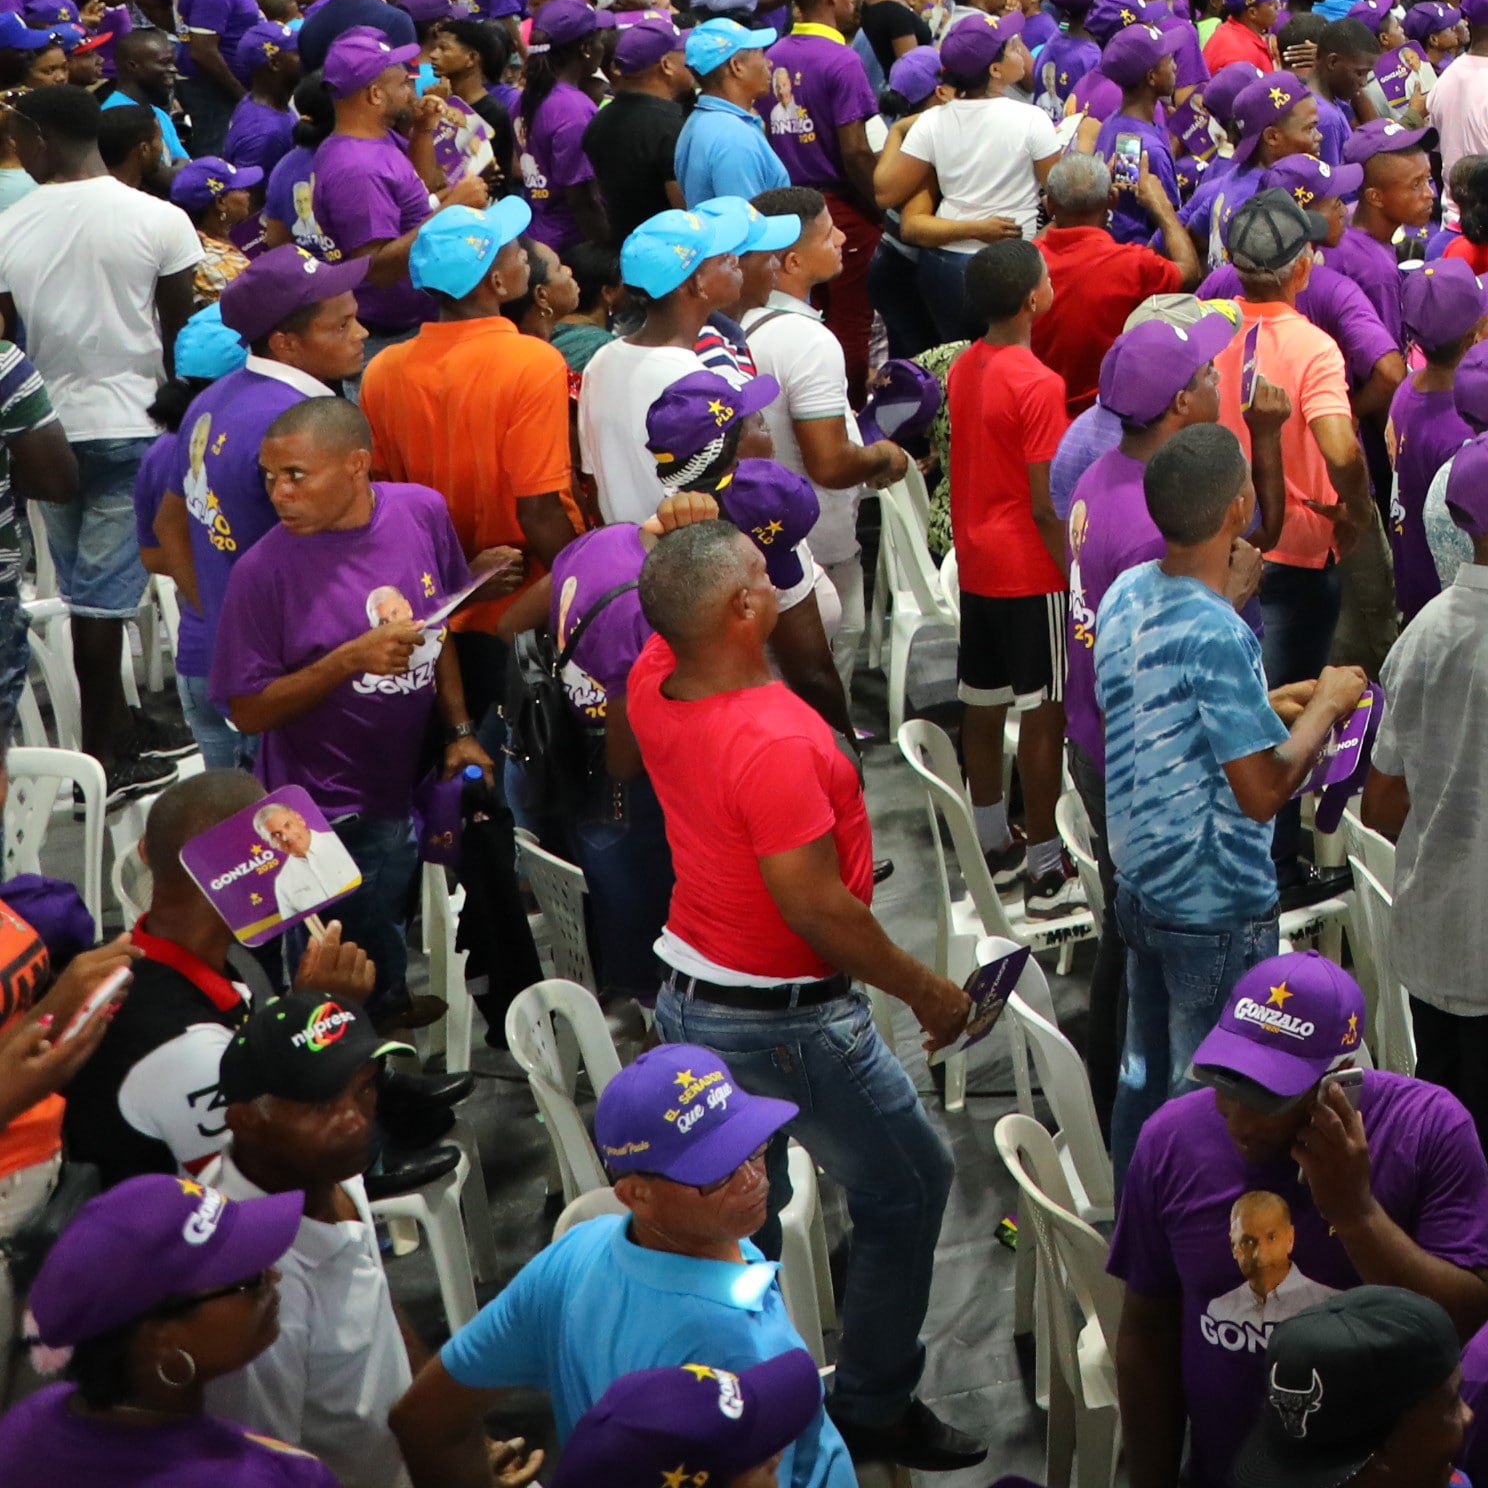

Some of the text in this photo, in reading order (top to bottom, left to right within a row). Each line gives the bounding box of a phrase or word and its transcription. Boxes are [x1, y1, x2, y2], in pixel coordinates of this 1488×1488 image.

[715, 406, 734, 427] PLD
[751, 527, 774, 545] PLD
[211, 850, 275, 891] GONZALO
[255, 857, 279, 876] 2020
[1234, 997, 1315, 1039] GONZALO
[664, 1070, 725, 1123] EL SENADOR
[677, 1104, 705, 1134] Que
